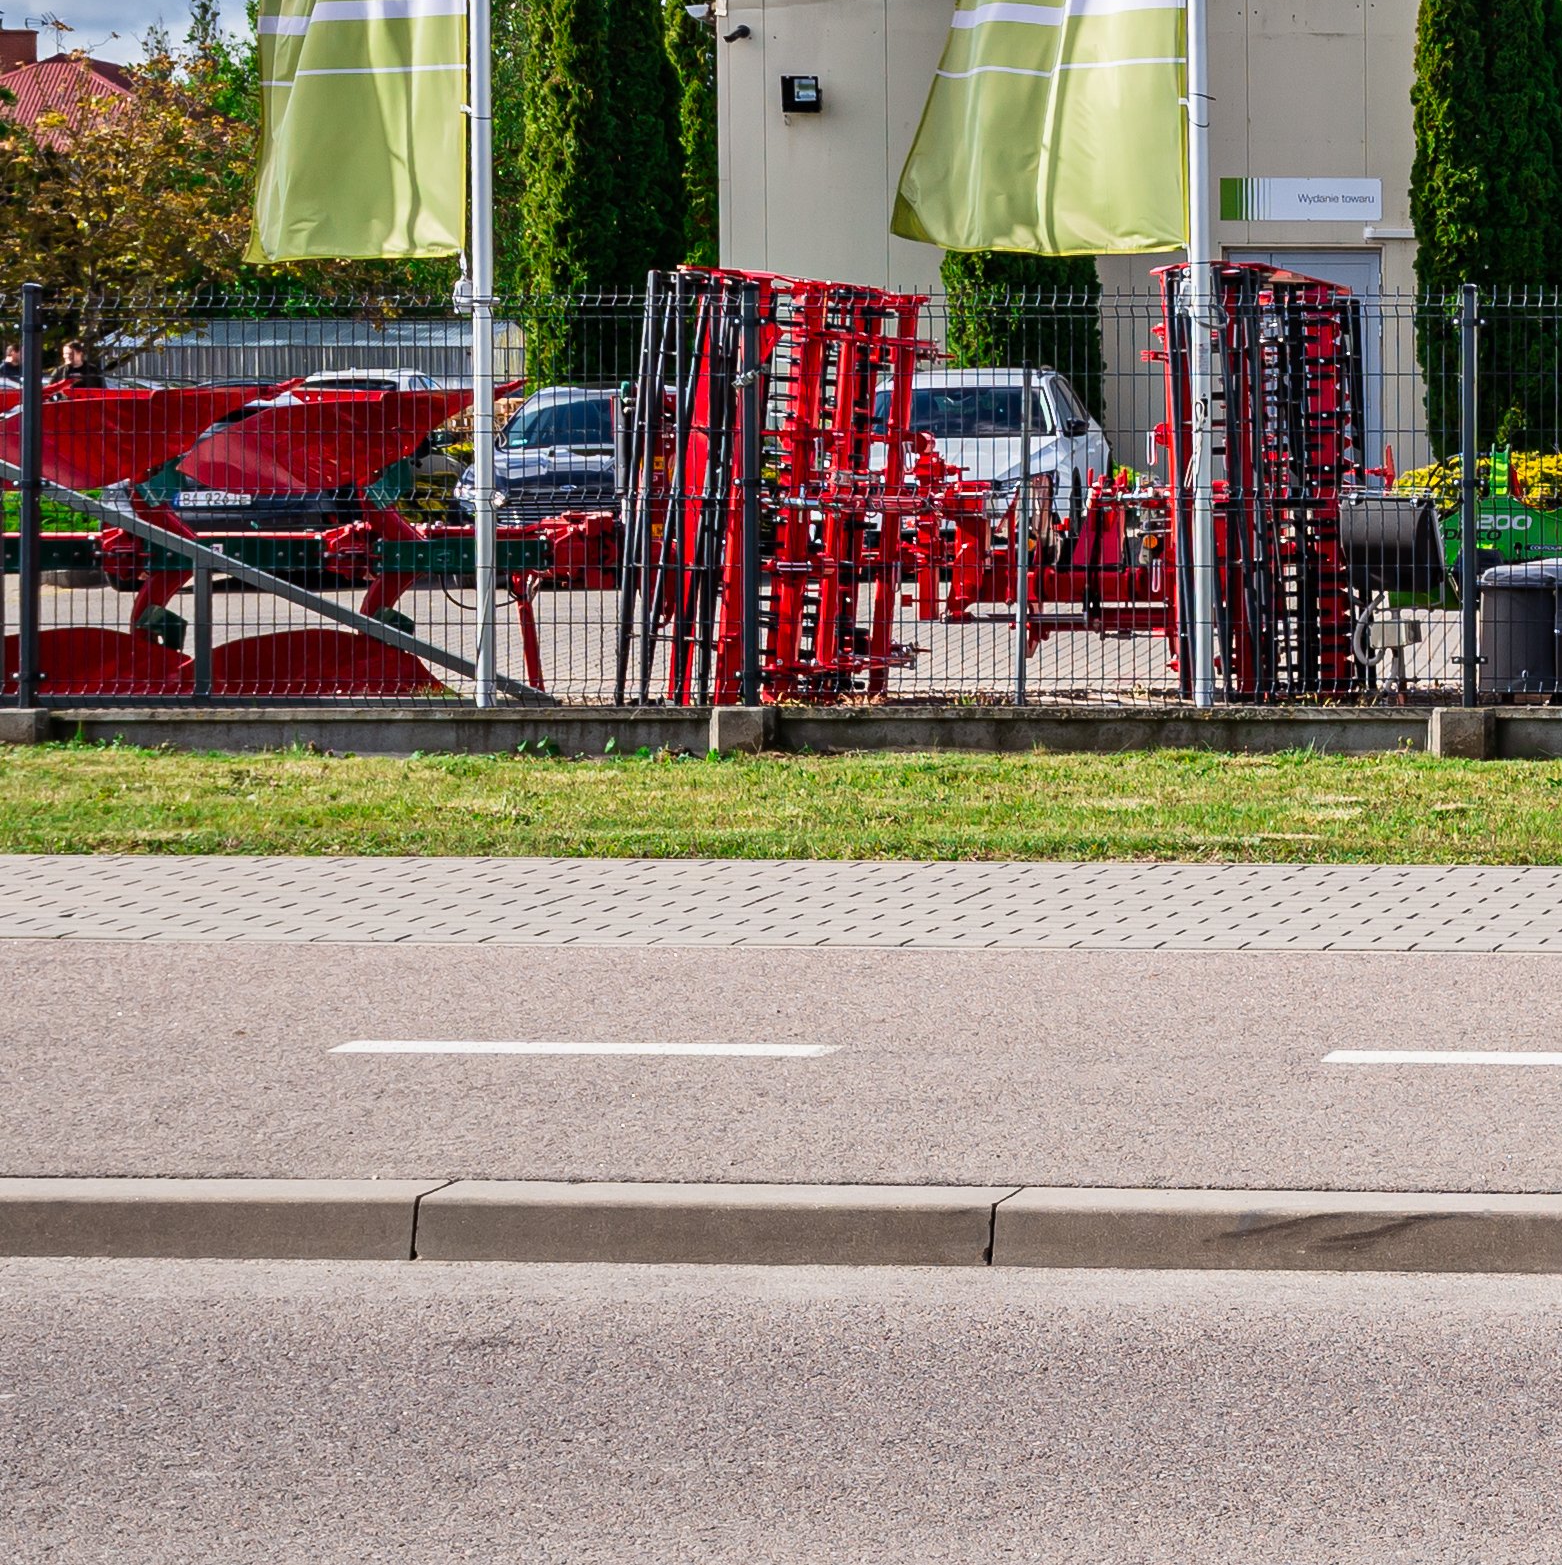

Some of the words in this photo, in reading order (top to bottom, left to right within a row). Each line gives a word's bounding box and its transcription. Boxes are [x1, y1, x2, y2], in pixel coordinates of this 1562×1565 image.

[1298, 194, 1339, 205] Wydanie
[1342, 194, 1375, 203] towaru
[1476, 515, 1533, 531] 200
